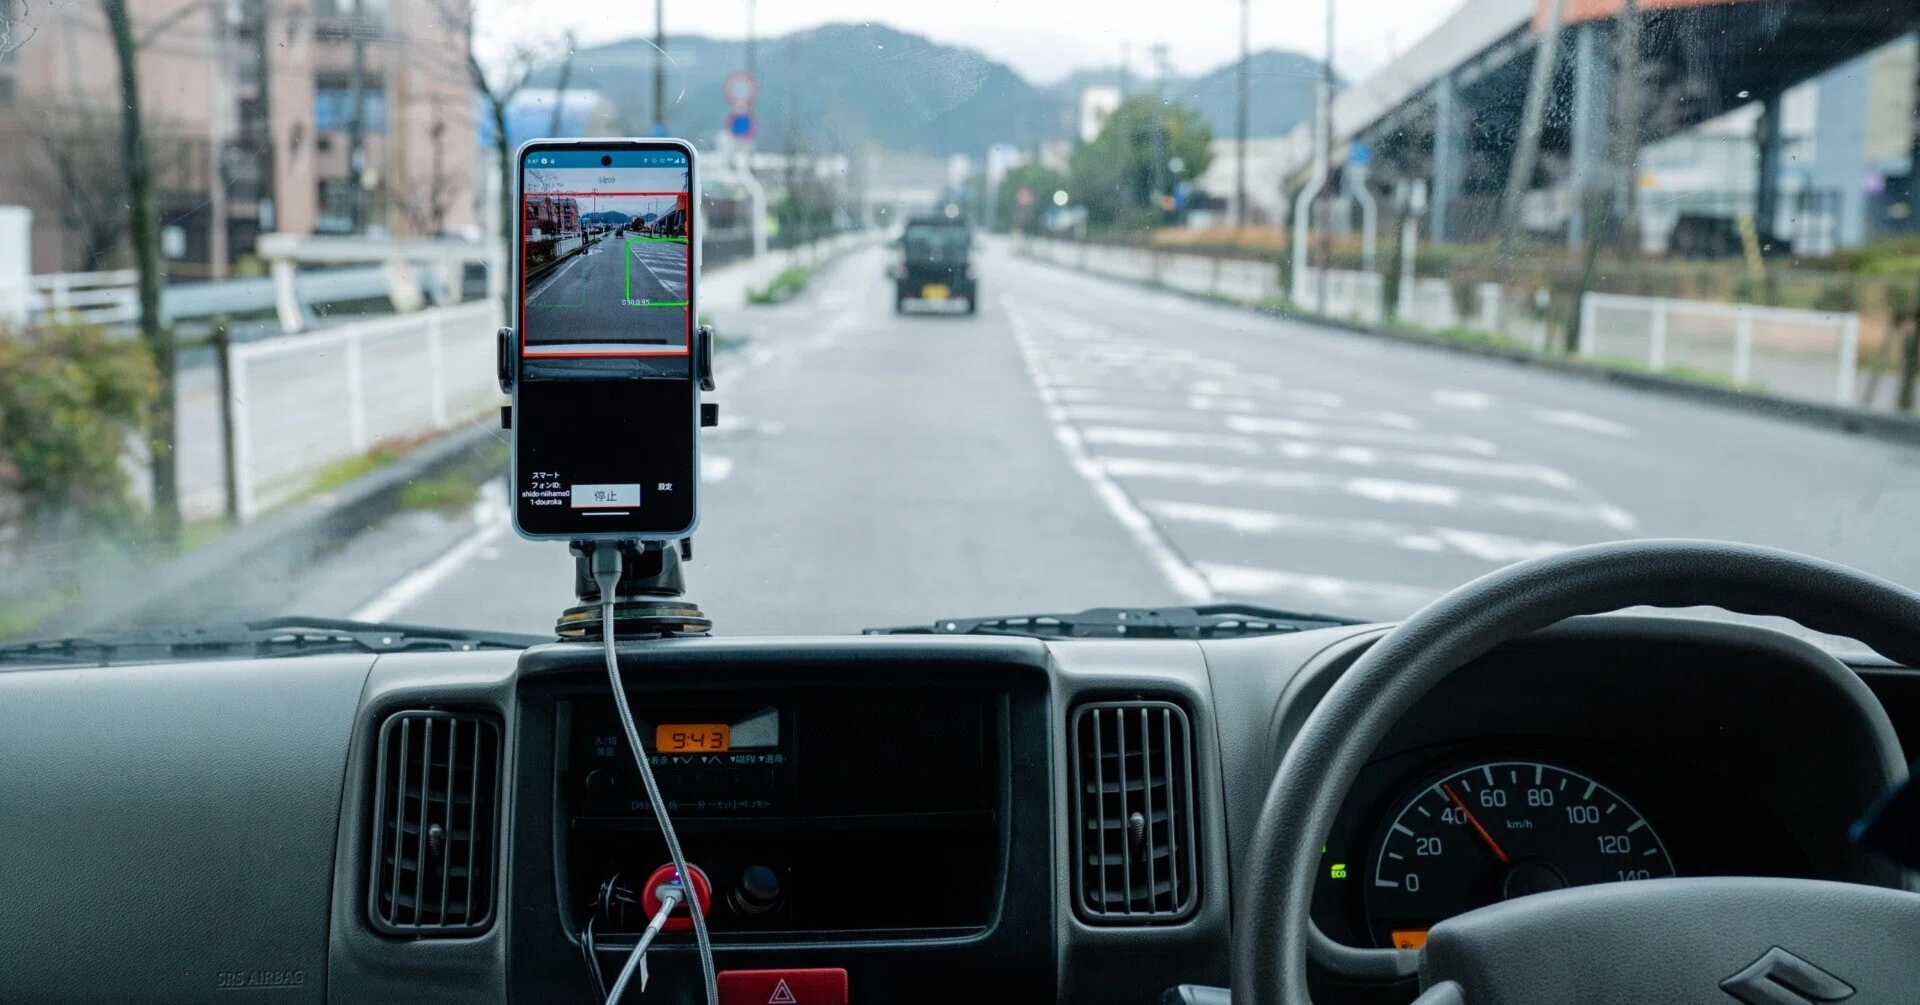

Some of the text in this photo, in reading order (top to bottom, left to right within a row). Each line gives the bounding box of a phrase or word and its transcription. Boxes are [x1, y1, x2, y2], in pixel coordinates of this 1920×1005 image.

[532, 471, 560, 479] スマート
[657, 482, 673, 491] 設定
[594, 490, 617, 503] 停止
[672, 732, 723, 749] 9:43
[1480, 789, 1506, 808] 60
[1527, 788, 1554, 807] 80
[1441, 807, 1467, 825] 40
[1566, 805, 1600, 824] 100
[1506, 818, 1533, 830] km/h
[1416, 837, 1442, 856] 20
[1597, 835, 1631, 854] 120
[1331, 870, 1347, 879] ECO
[1406, 873, 1420, 892] 0
[217, 969, 304, 987] SRS AIRBAG
